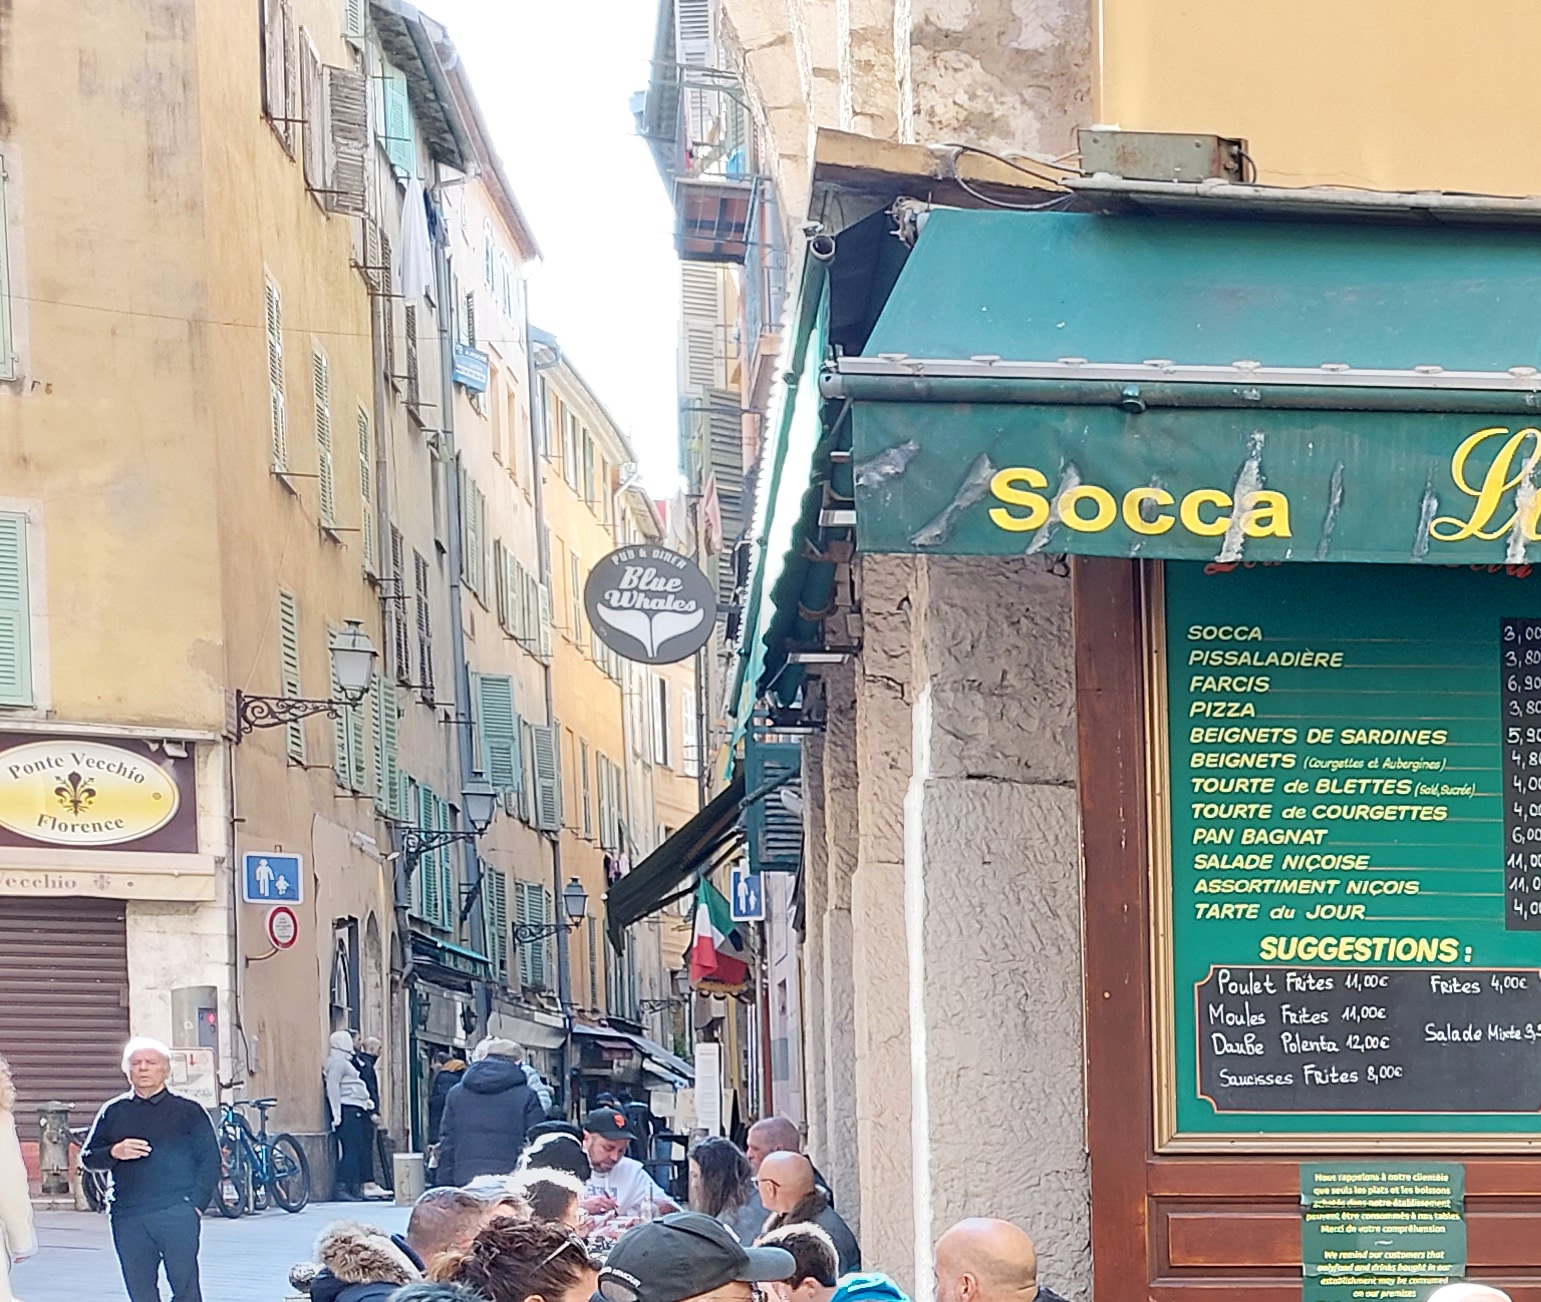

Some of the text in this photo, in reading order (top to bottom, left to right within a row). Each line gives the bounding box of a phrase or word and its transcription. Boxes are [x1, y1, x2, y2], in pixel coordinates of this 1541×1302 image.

[987, 466, 1292, 539] Socca
[611, 549, 635, 565] PUB
[619, 565, 683, 592] Blue
[604, 590, 697, 612] Whales
[1187, 625, 1263, 641] SOCCA
[1188, 647, 1541, 668] PISSALADIÈRE 3,80
[1189, 675, 1541, 693] FARCIS 6,90
[1189, 701, 1256, 718] PIZZA
[1189, 727, 1298, 744] BEIGNETS
[1306, 728, 1335, 744] DE
[1340, 729, 1448, 745] SARDINES
[8, 752, 145, 785] Ponte Vecchio
[1190, 752, 1297, 768] BEIGNETS
[1190, 778, 1275, 794] TOURTE
[1283, 779, 1309, 794] de
[1315, 778, 1413, 795] BLETTES
[1191, 803, 1273, 819] TOURTE
[1281, 805, 1307, 819] de
[1311, 804, 1448, 821] COURGETTES
[37, 813, 125, 834] Florence
[1192, 828, 1235, 845] PAN
[1241, 828, 1328, 845] BAGNAT
[1193, 854, 1274, 870] SALADE
[1281, 854, 1371, 872] NIÇOISE
[0, 874, 77, 890] ecchio
[1194, 879, 1340, 894] ASSORTIMENT
[1346, 880, 1420, 896] NIÇOIS
[1195, 903, 1260, 919] TARTE
[1270, 905, 1296, 919] du
[1305, 904, 1366, 920] JOUR
[1218, 969, 1277, 995] Poulet
[1208, 1001, 1266, 1027] Moules
[1424, 1023, 1483, 1042] Salade
[1280, 1032, 1340, 1054] Polenta
[1219, 1068, 1294, 1087] Saucisses
